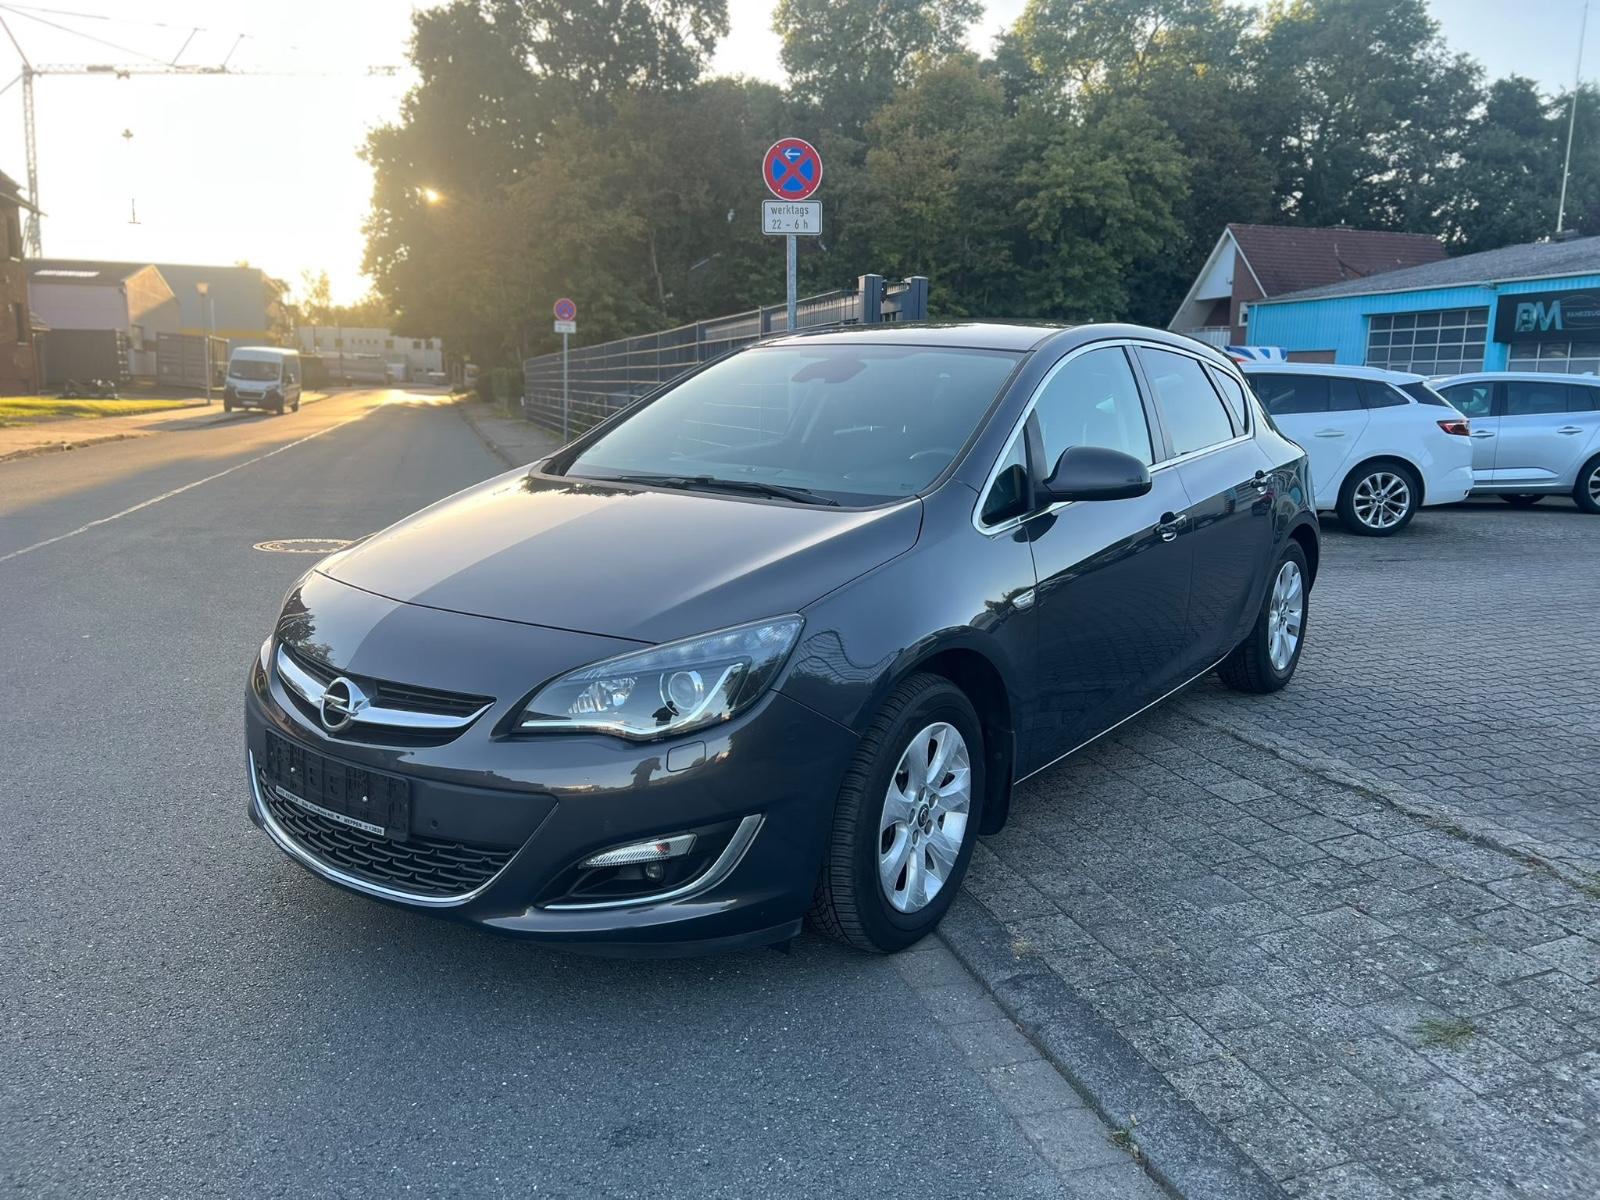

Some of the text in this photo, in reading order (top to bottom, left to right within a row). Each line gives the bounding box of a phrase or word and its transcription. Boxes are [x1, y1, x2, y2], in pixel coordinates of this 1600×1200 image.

[770, 205, 809, 217] werktags
[771, 219, 782, 230] 22
[794, 219, 800, 230] 6
[803, 218, 809, 230] h
